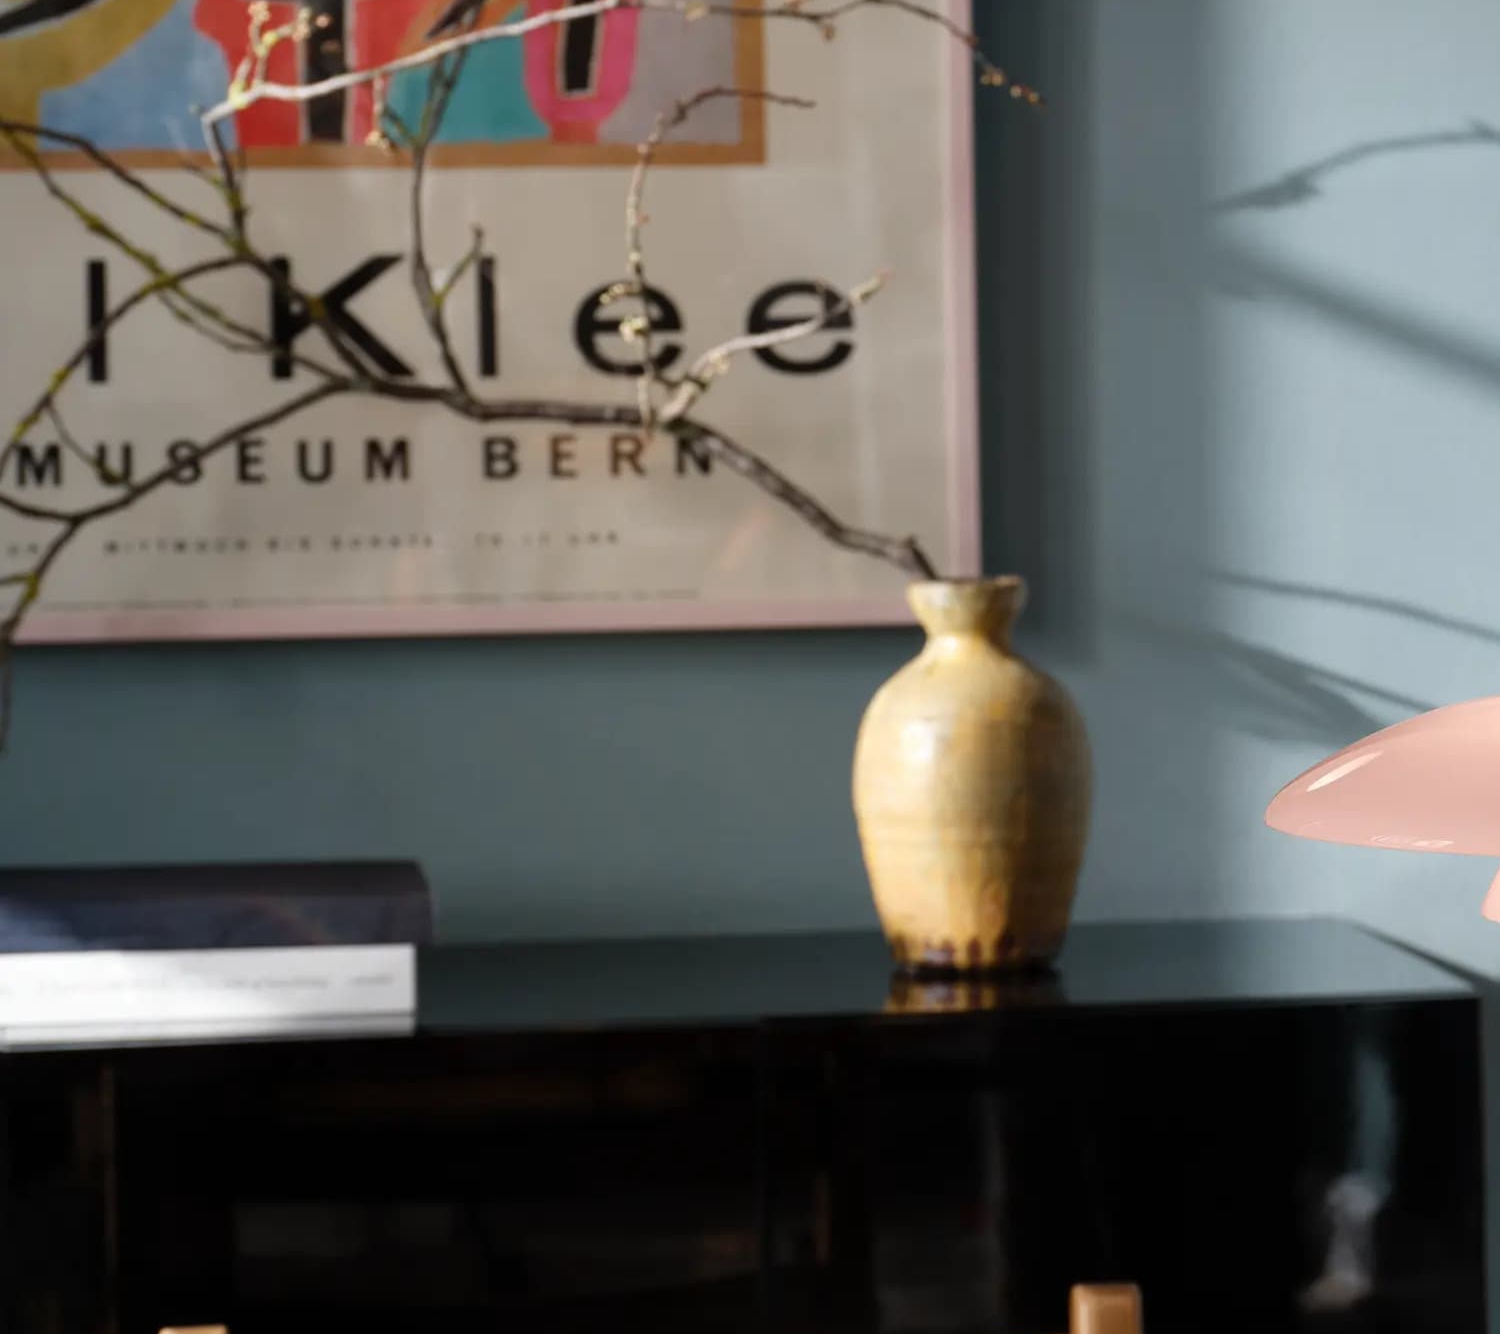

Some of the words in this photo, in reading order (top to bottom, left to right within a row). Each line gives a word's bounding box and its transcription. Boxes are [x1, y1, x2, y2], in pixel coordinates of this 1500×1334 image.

[270, 253, 855, 380] Klee
[15, 437, 410, 487] MUSEUM
[482, 433, 712, 481] BERN
